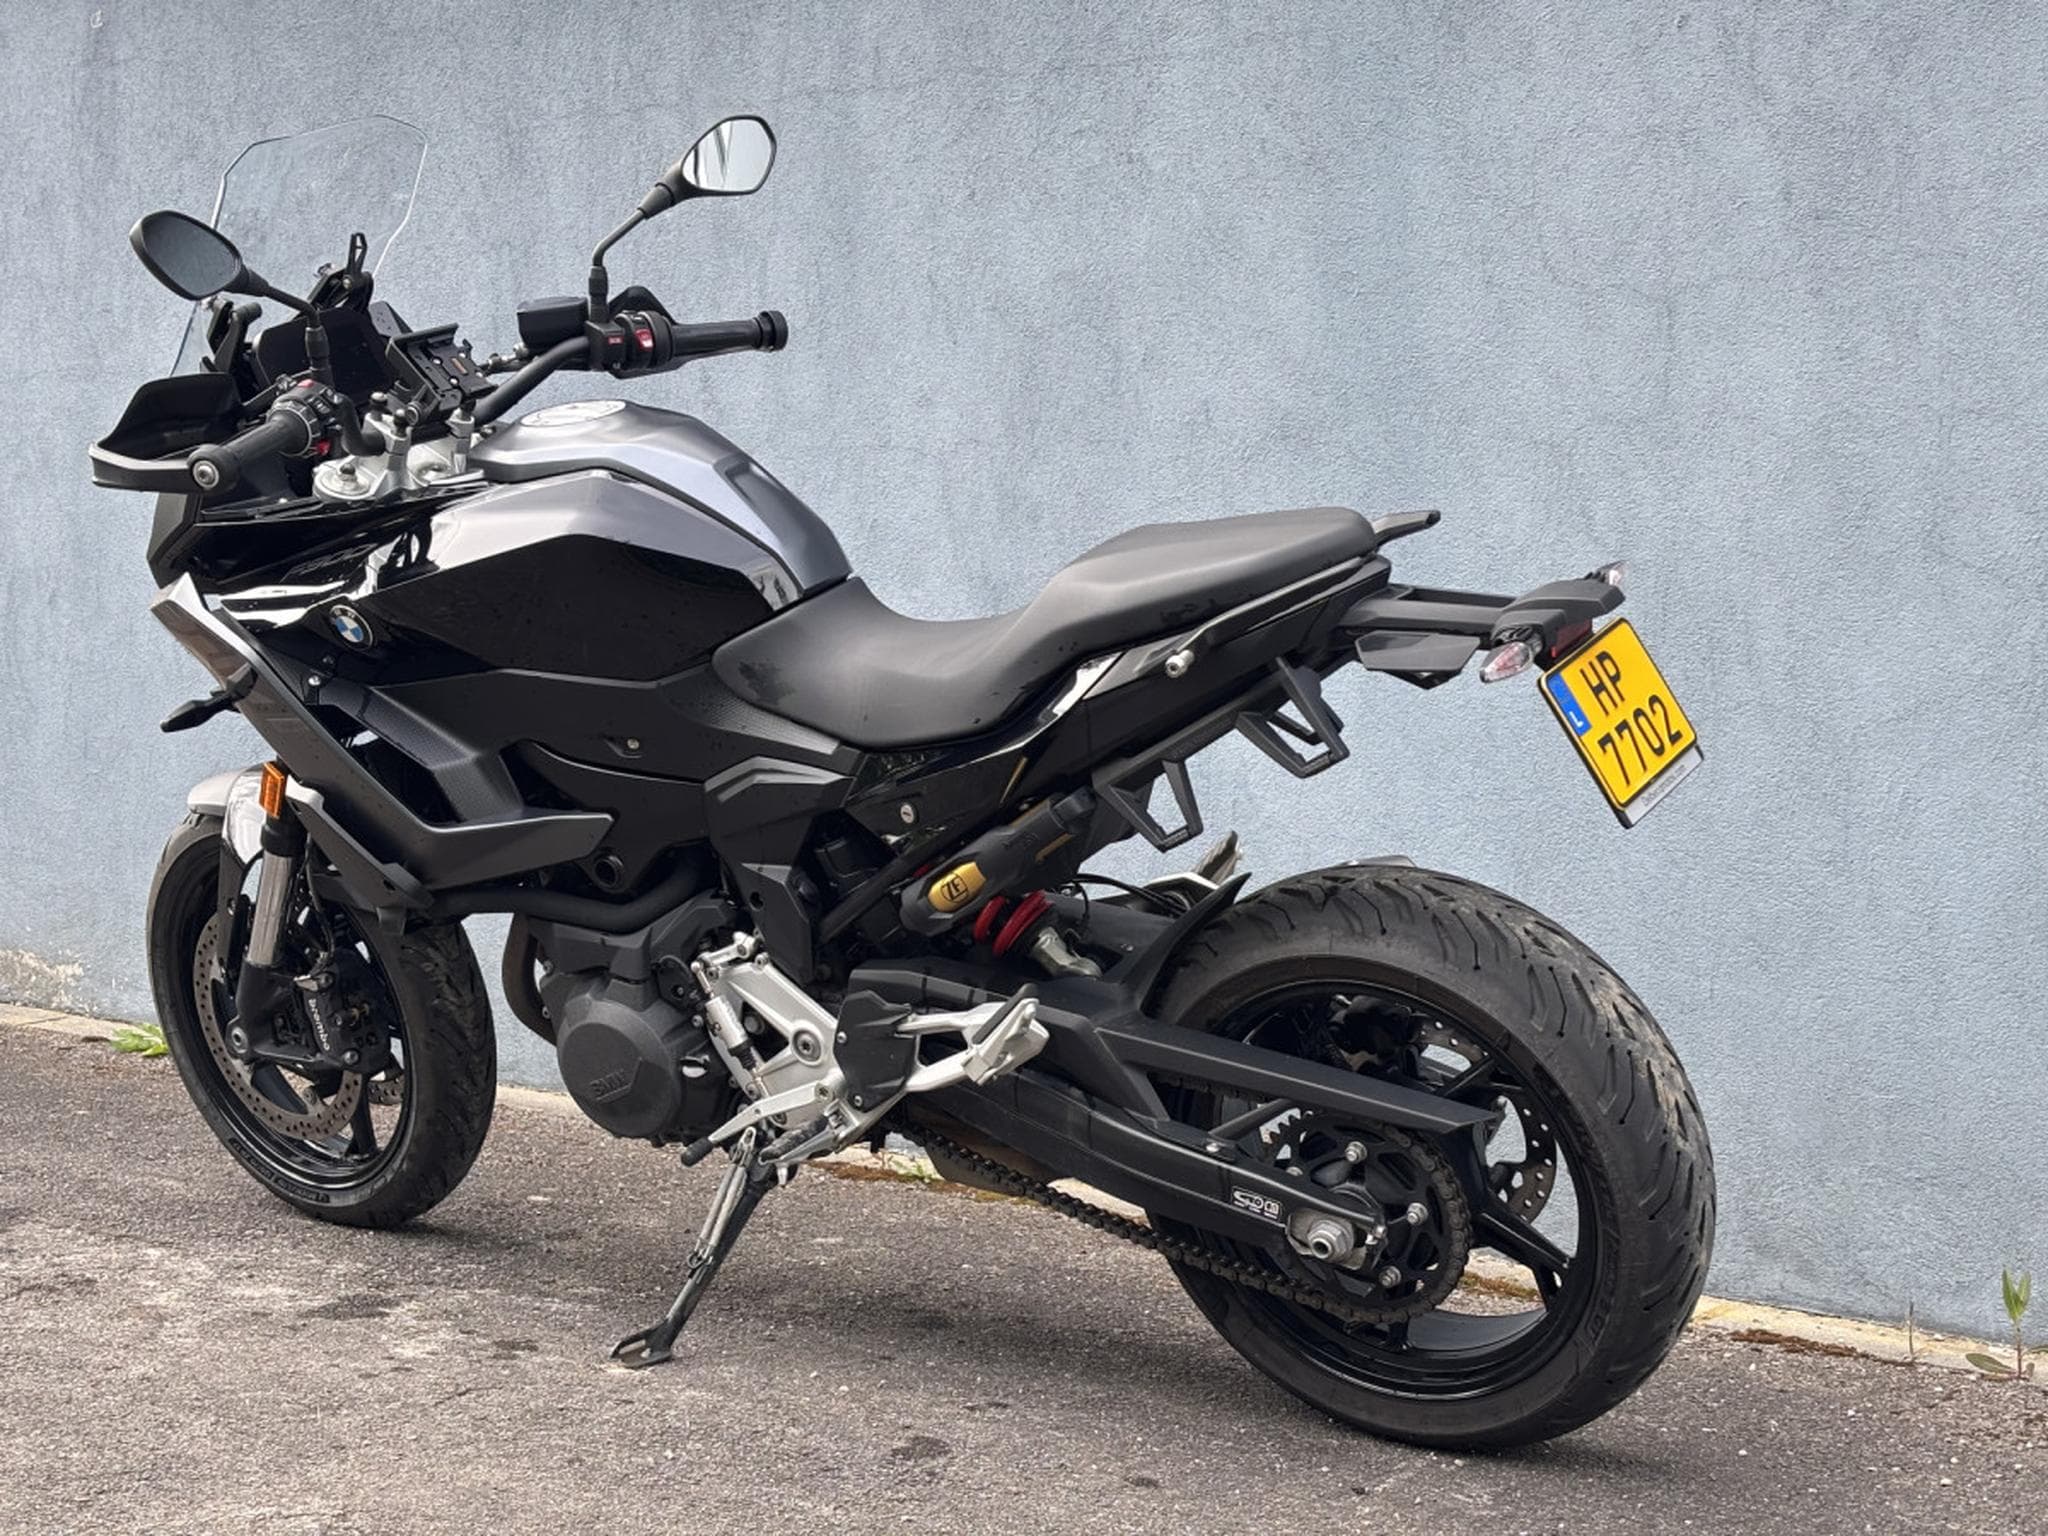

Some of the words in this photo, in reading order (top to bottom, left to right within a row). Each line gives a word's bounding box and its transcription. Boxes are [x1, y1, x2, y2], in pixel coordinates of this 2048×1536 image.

[1579, 650, 1625, 717] HP
[1597, 694, 1684, 788] 7702
[941, 876, 968, 902] ZF
